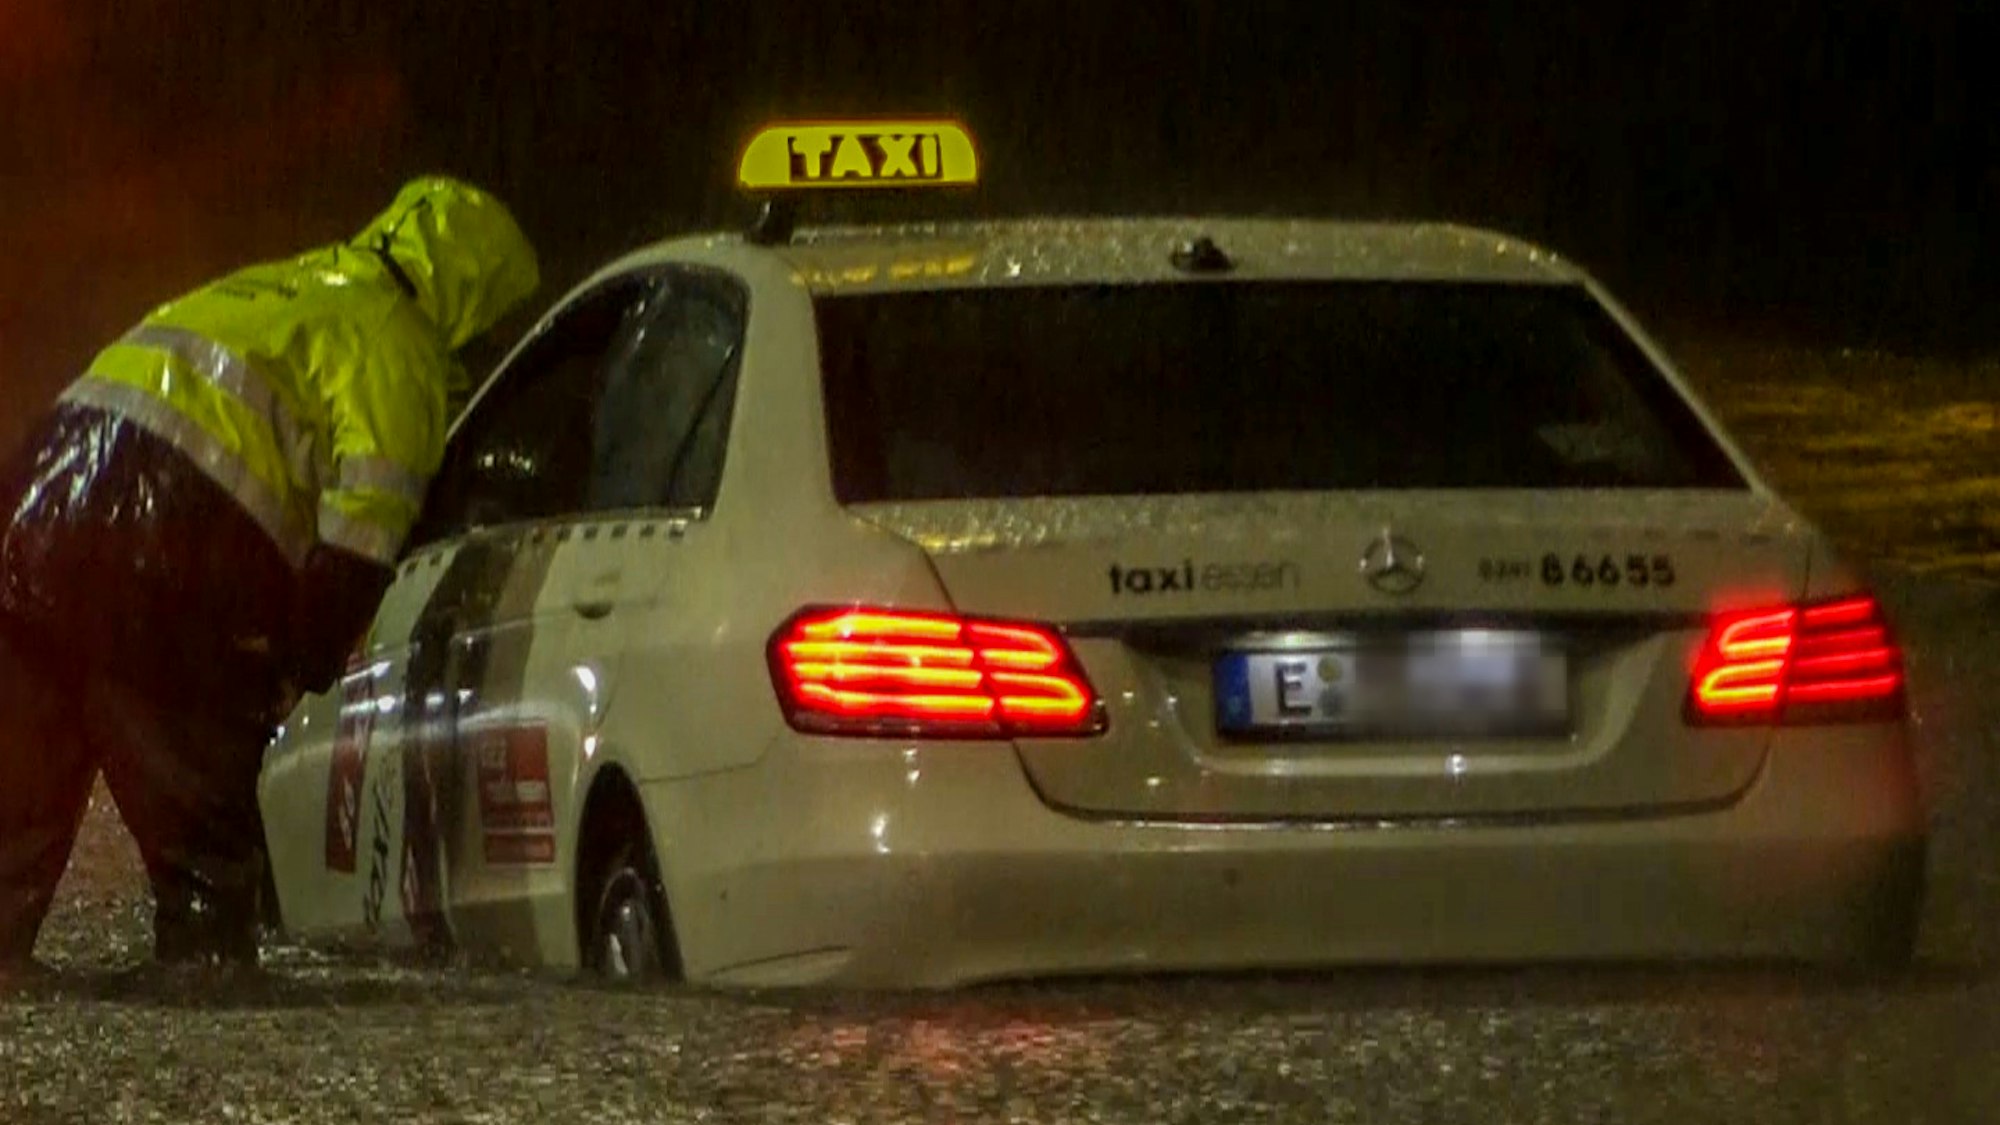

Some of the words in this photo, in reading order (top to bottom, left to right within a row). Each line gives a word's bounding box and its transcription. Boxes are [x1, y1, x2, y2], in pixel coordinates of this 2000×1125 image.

[790, 133, 942, 180] TAXI
[1108, 558, 1195, 594] taxi
[1540, 552, 1676, 587] 86655
